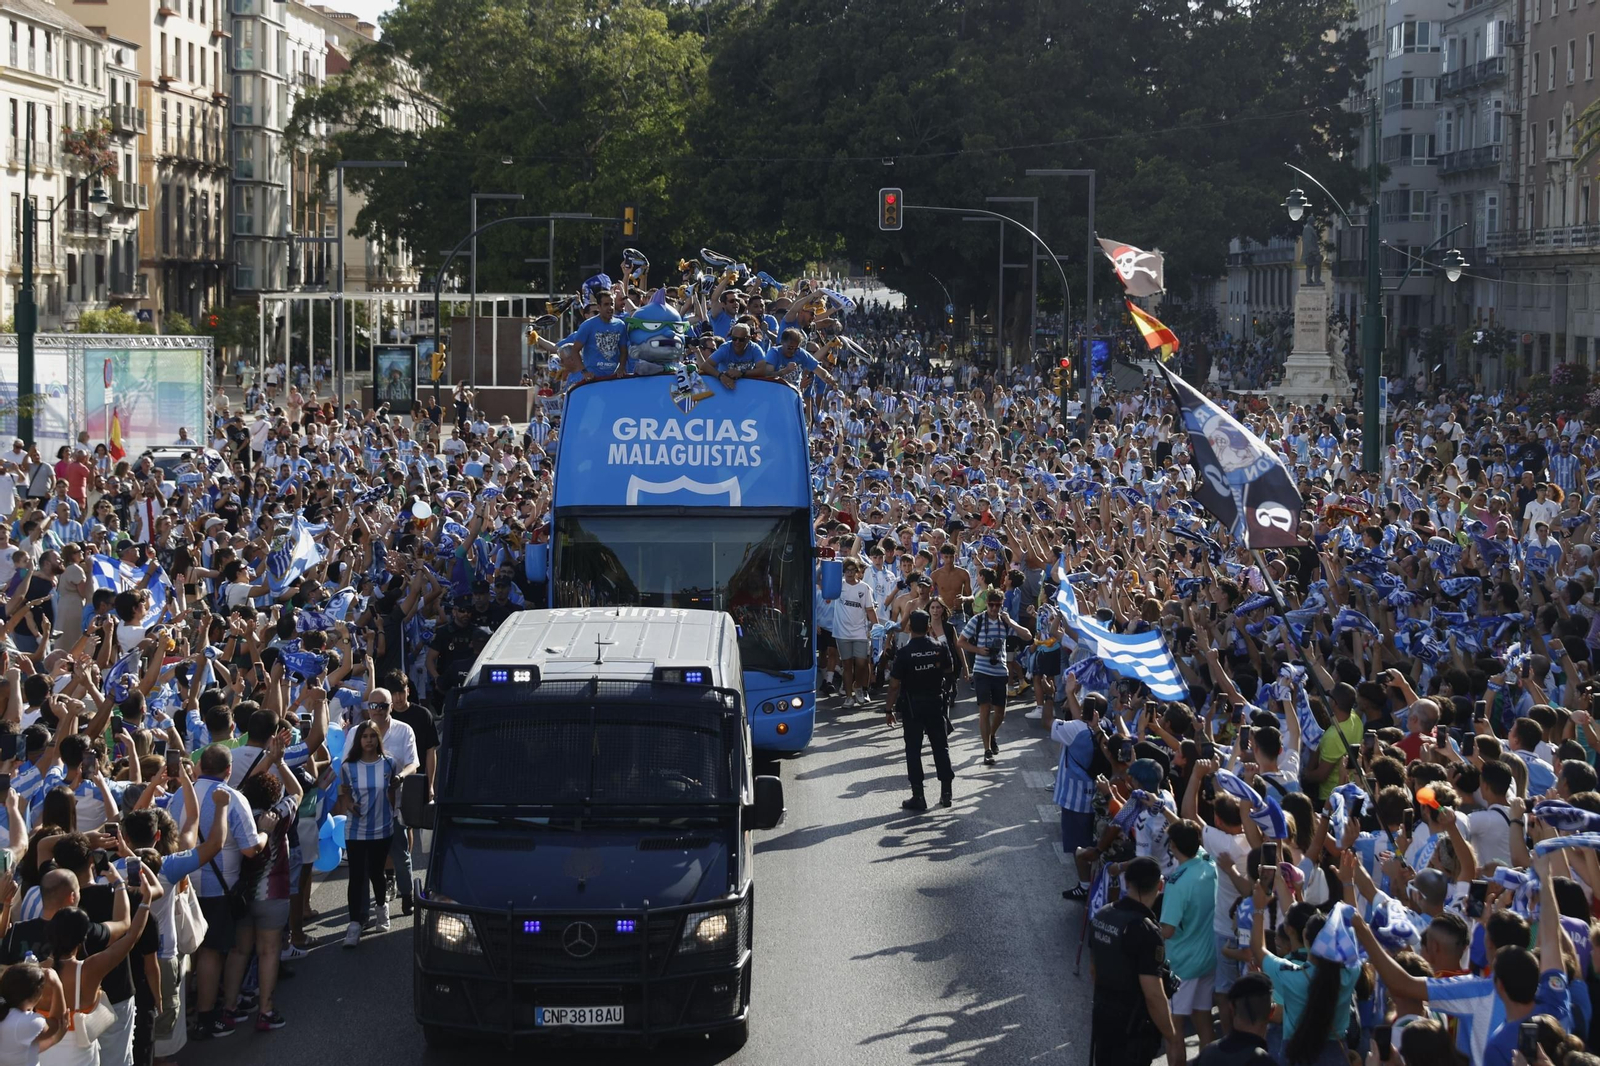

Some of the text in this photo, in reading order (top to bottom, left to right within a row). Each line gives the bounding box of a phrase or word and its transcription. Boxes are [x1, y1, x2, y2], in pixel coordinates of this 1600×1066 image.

[612, 417, 758, 442] GRACIAS
[607, 443, 761, 467] MALAGUISTAS
[802, 637, 809, 648] 7
[1105, 924, 1119, 936] LOCAL
[543, 1008, 622, 1023] CNP3818AU
